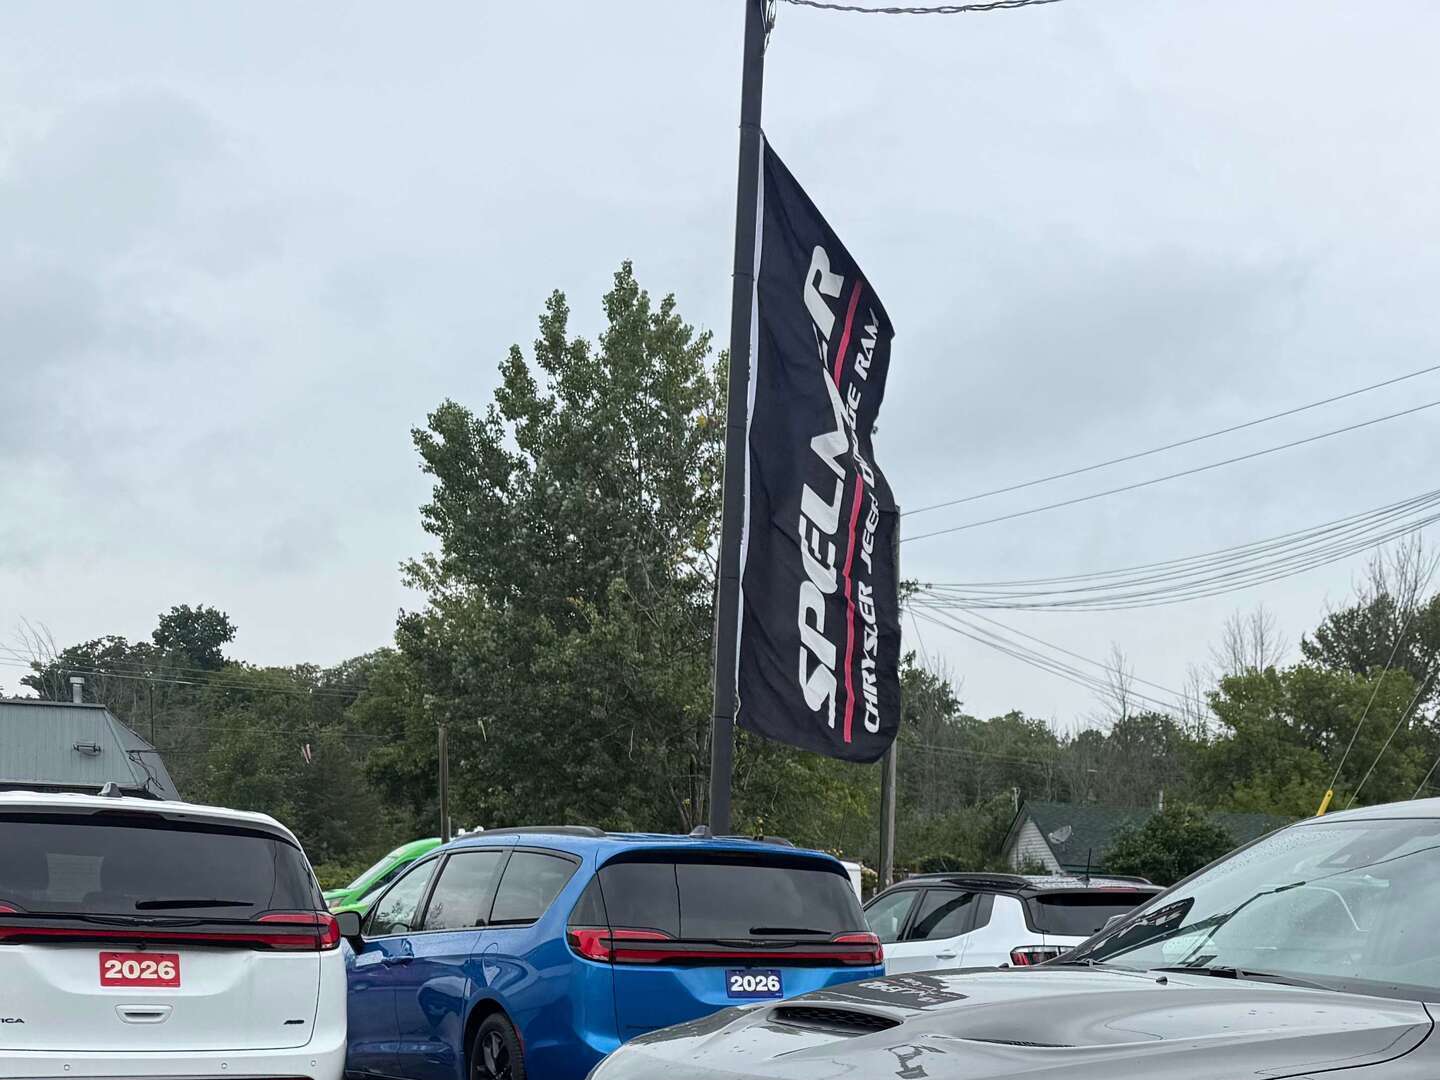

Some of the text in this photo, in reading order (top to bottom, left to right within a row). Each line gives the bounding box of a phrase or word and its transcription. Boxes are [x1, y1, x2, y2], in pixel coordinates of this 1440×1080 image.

[854, 307, 880, 381] RAM
[798, 245, 850, 729] SPELMR
[861, 492, 879, 575] JEEP
[858, 580, 880, 734] CHRYSLER
[104, 960, 176, 980] 2026
[730, 975, 781, 992] 2026
